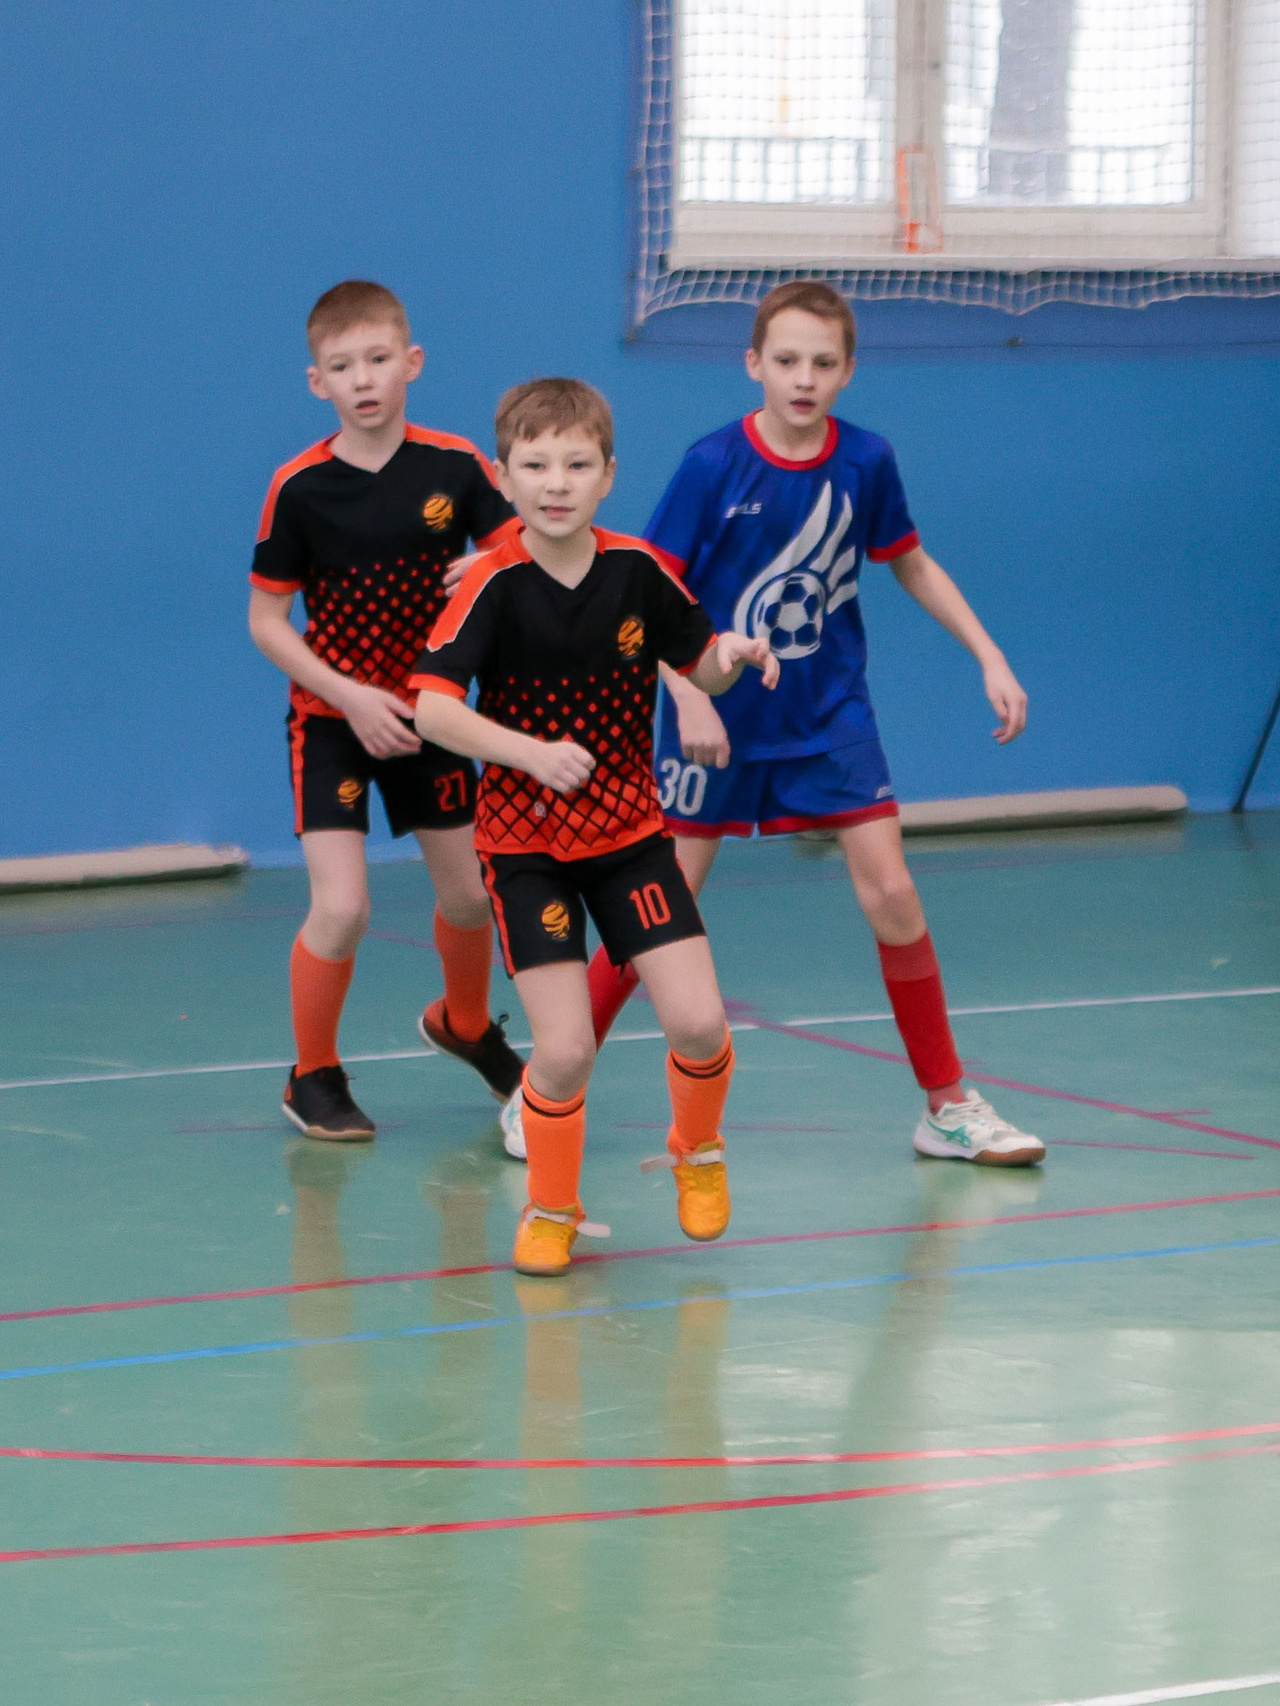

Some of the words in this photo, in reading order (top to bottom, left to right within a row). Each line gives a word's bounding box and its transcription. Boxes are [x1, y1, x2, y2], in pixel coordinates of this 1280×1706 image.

[434, 770, 467, 811] 27
[657, 758, 707, 816] 30
[629, 883, 671, 930] 10
